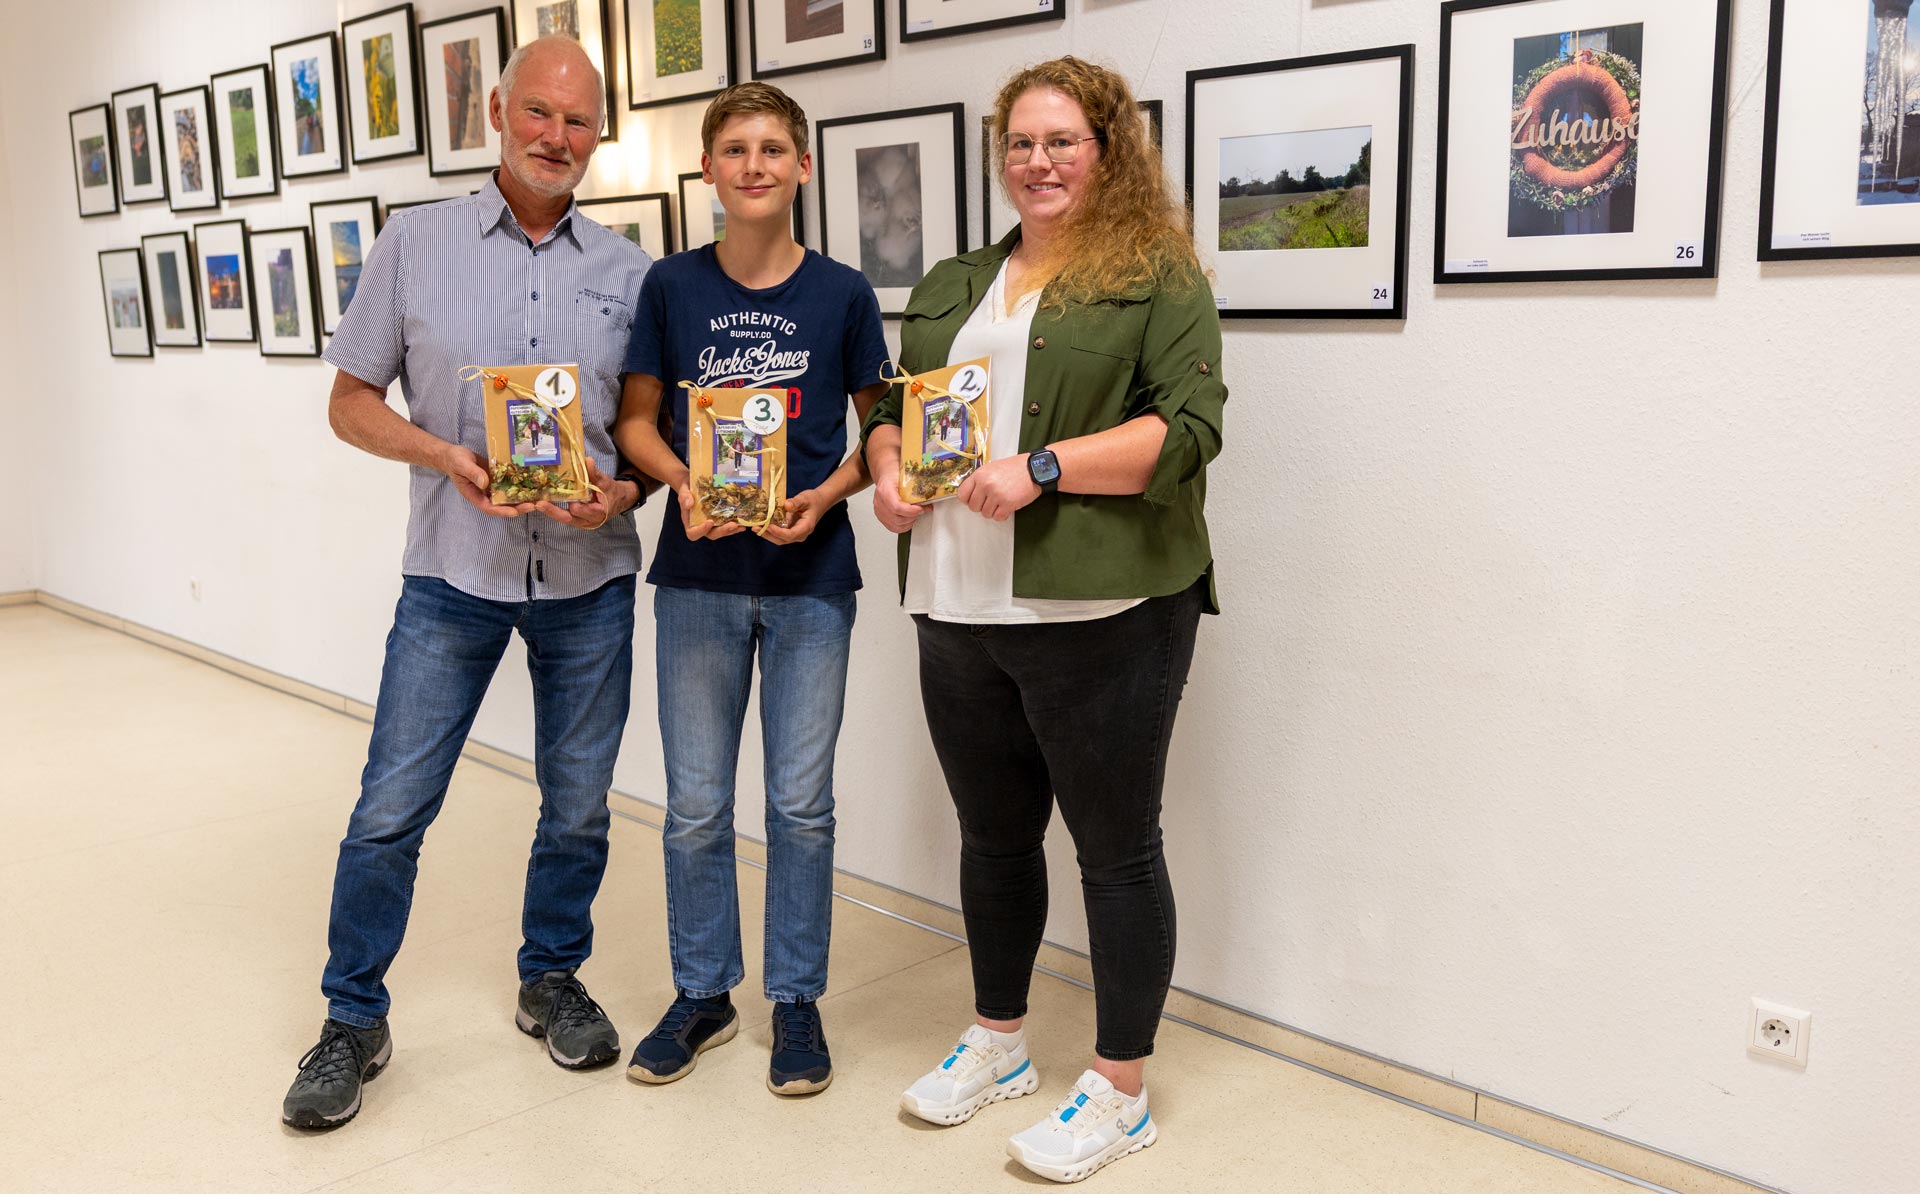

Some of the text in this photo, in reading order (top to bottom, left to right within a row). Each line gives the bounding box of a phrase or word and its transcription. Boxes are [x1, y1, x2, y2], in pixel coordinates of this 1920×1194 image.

[863, 39, 873, 49] 19
[717, 75, 725, 85] 17
[1511, 106, 1640, 150] Zuhause
[1676, 246, 1695, 259] 26
[1373, 288, 1388, 300] 24
[710, 311, 797, 336] AUTHENTIC
[730, 330, 772, 339] SUPPLY.CO
[698, 340, 810, 386] Jack&Jones
[546, 371, 566, 396] 1.
[960, 370, 981, 392] 2.
[754, 397, 776, 422] 3.
